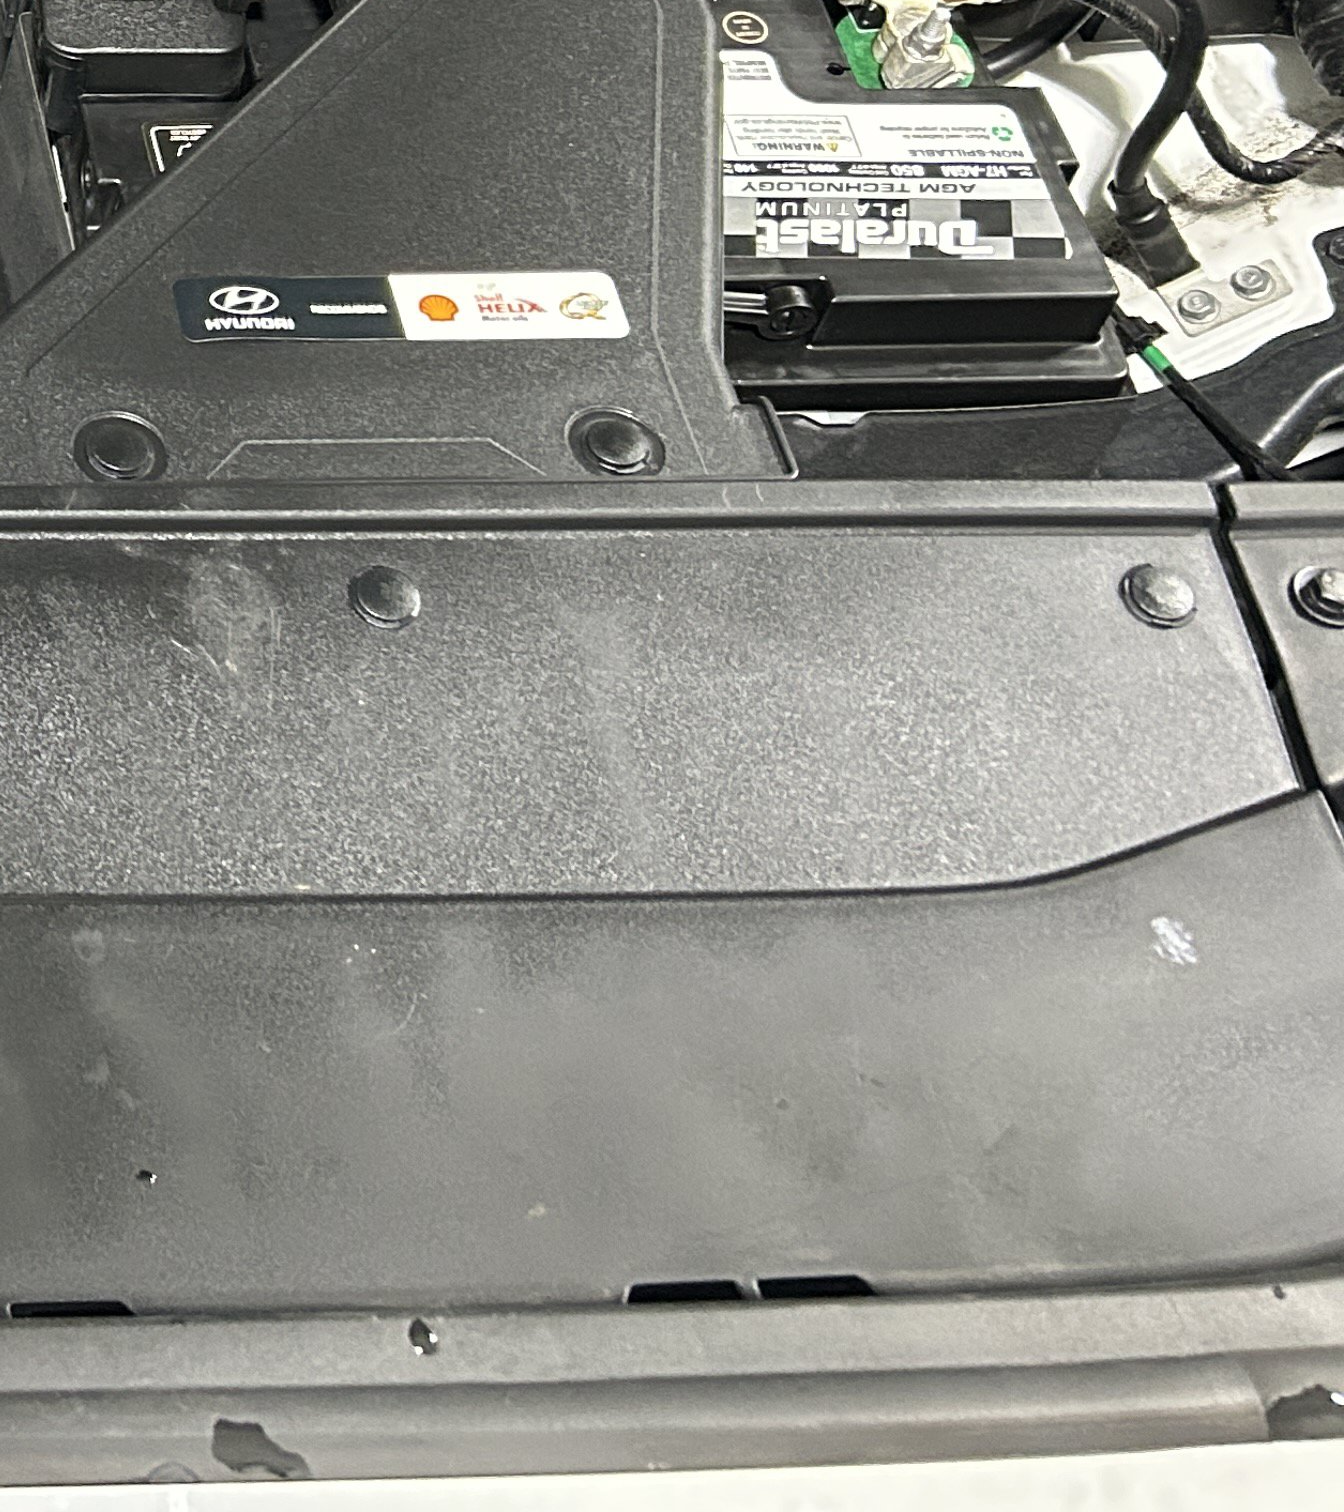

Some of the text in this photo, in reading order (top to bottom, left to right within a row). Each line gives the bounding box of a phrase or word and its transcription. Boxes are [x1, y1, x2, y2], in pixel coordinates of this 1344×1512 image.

[908, 148, 1025, 158] NON-SPILLABLE
[741, 181, 977, 193] AGM TECHNOLOGY
[755, 201, 908, 217] PLATINUM
[756, 219, 995, 256] Duralast
[477, 299, 546, 313] HELIX
[204, 317, 296, 331] HYUNDAI
